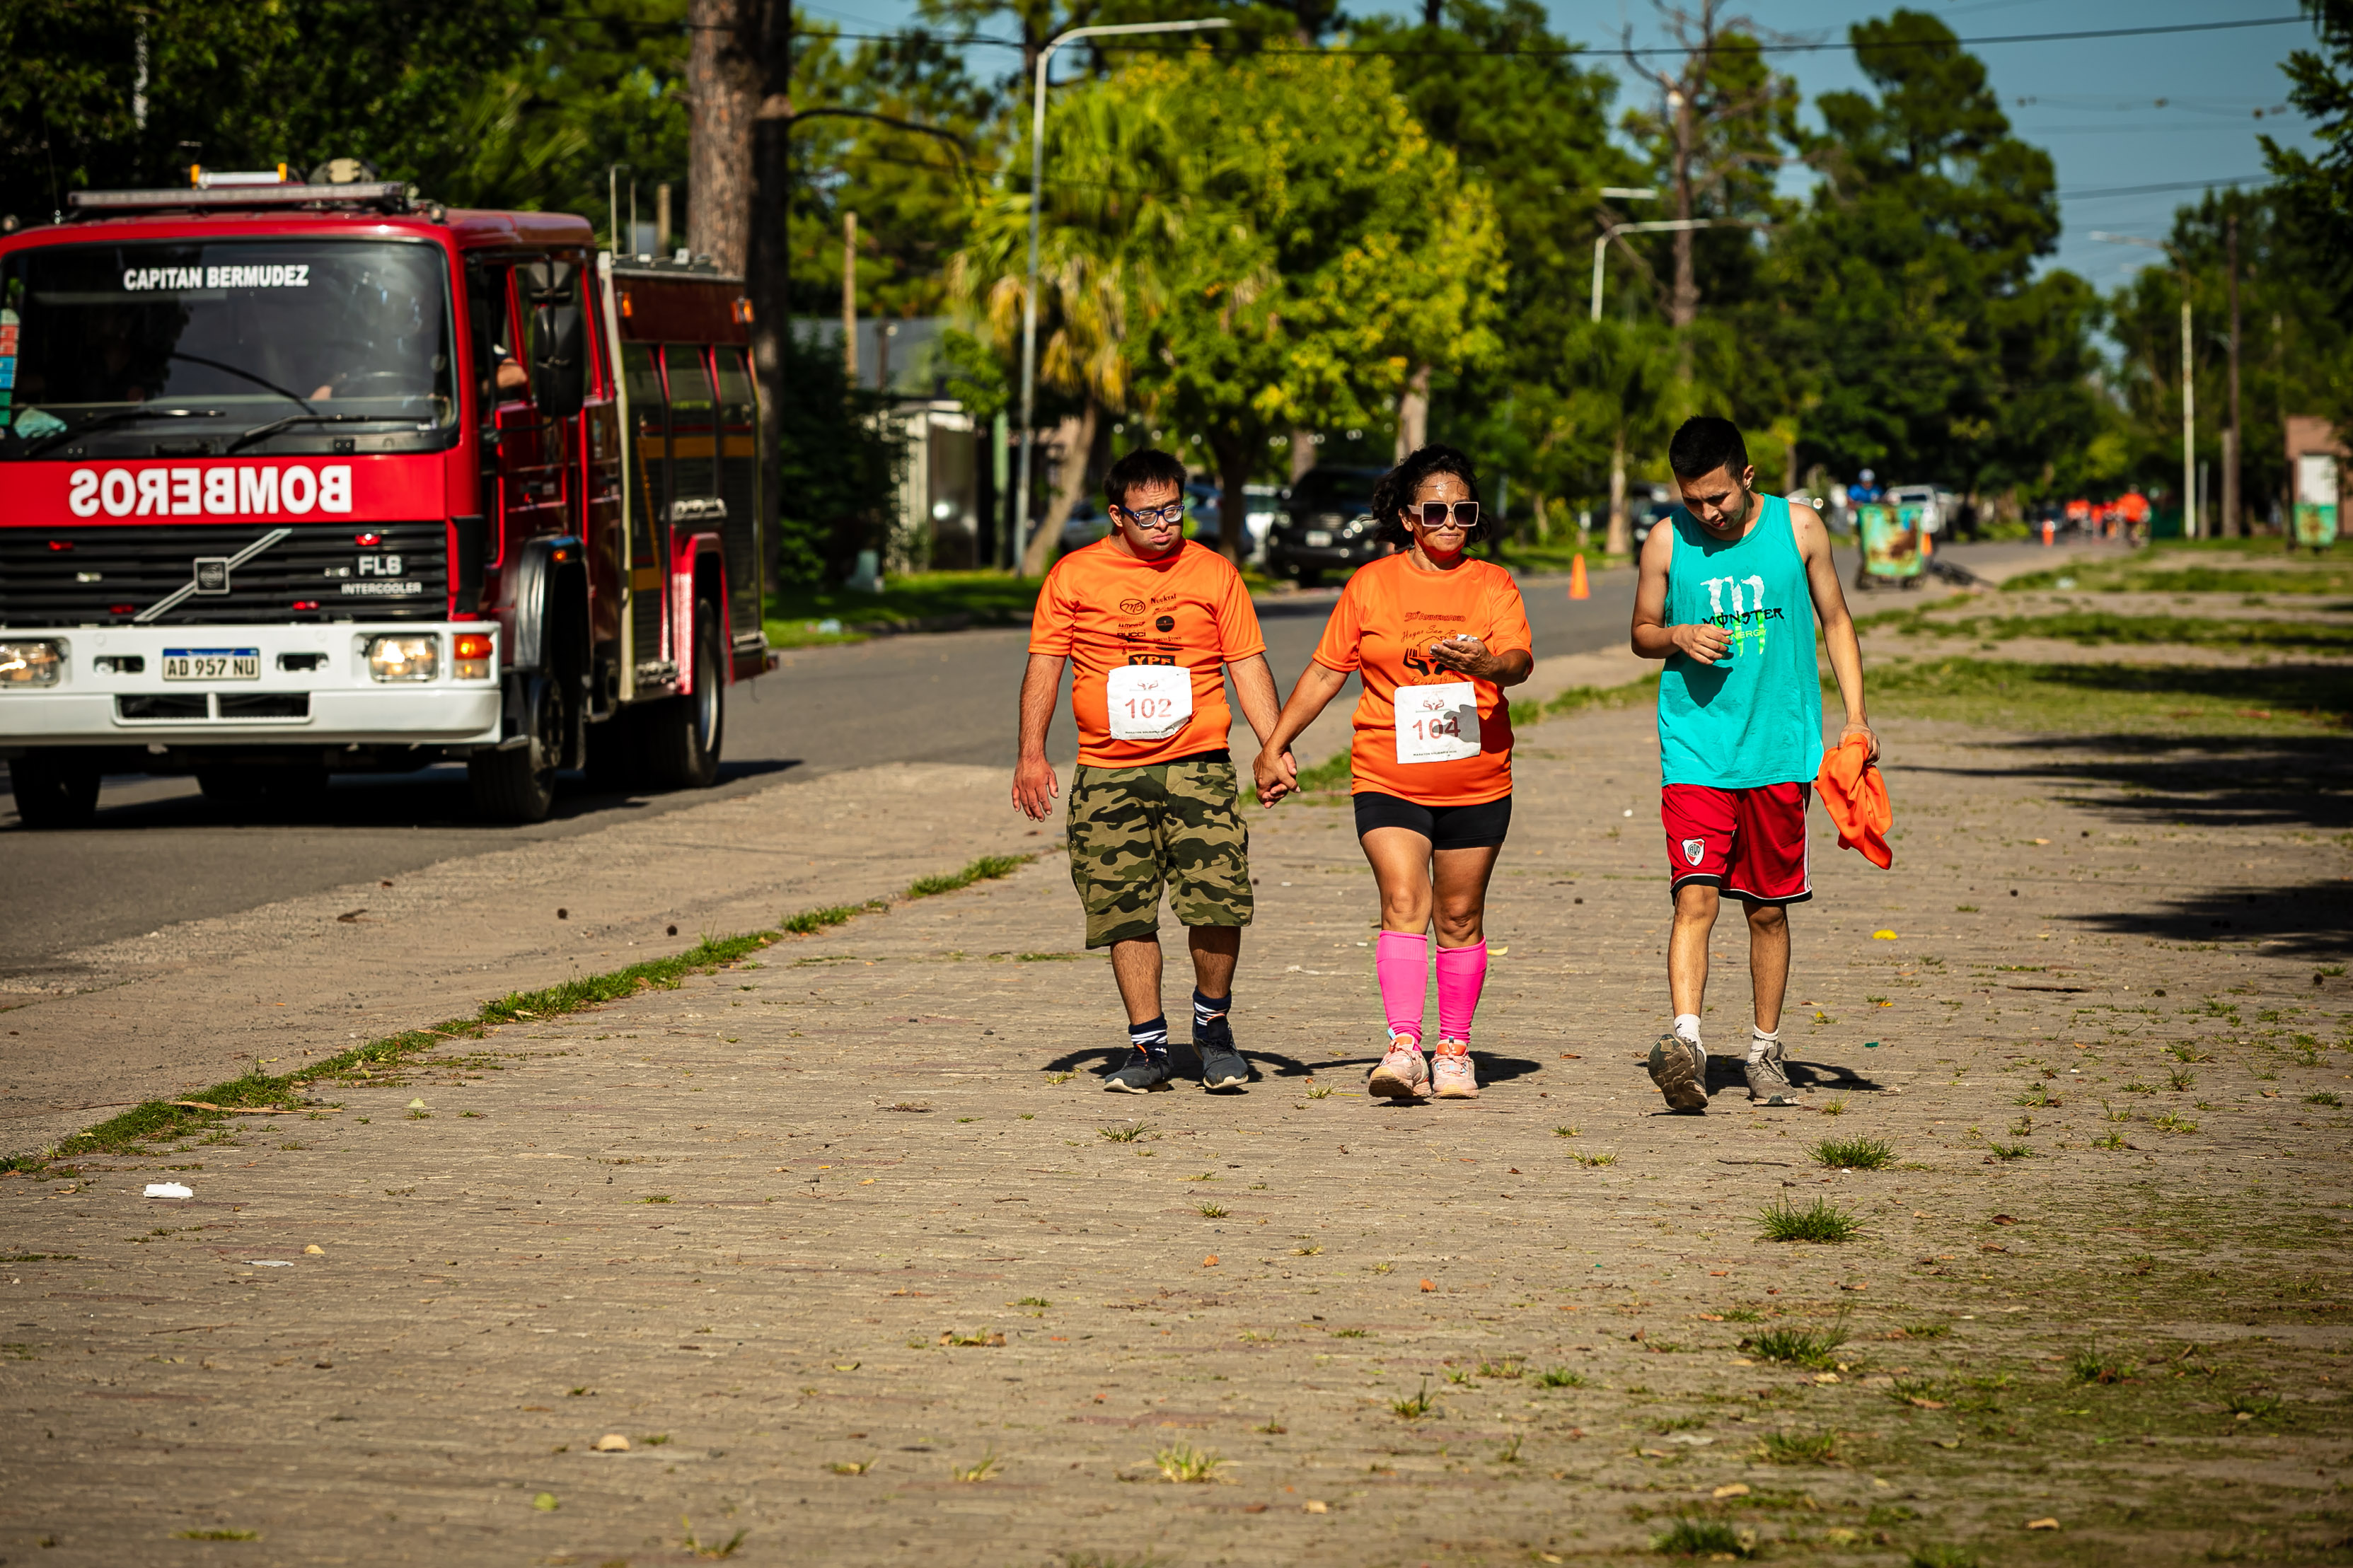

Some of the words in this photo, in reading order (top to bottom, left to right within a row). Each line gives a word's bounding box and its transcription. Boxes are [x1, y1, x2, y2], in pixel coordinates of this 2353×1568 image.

[124, 267, 202, 290] CAPITAN
[207, 265, 309, 289] BERMUDEZ
[341, 581, 422, 595] INTERCOOLER
[1418, 613, 1467, 622] ANIVERSARIO
[1701, 608, 1784, 629] MONSTER
[1726, 628, 1767, 640] NERGY
[168, 658, 189, 676] AD
[195, 658, 226, 676] 957
[233, 658, 255, 676] NU
[1133, 656, 1172, 666] YPF
[1125, 698, 1172, 719] 102
[1412, 716, 1462, 741] 104
